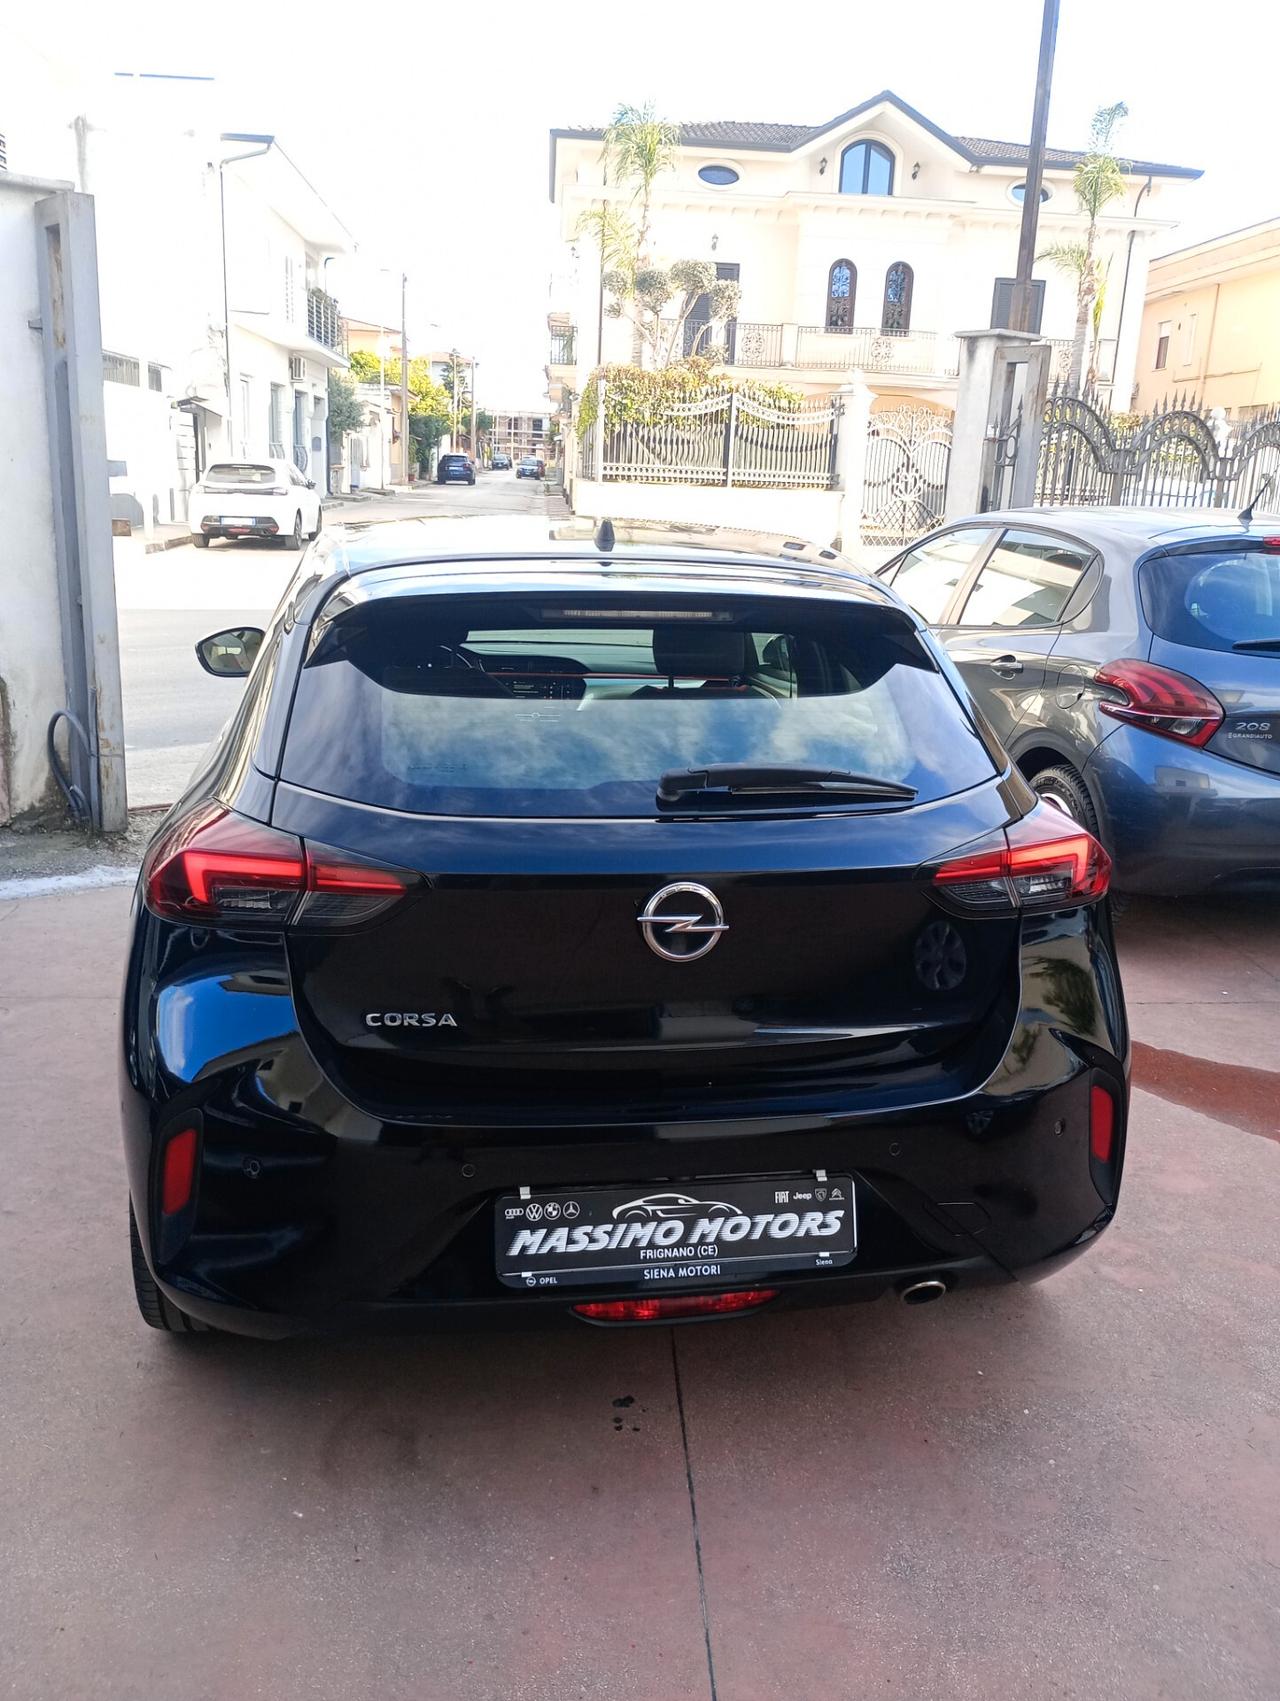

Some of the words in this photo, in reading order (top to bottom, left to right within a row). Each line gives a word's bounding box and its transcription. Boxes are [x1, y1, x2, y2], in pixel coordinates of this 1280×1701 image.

[1235, 722, 1270, 731] 208
[365, 1012, 458, 1027] CORSA
[774, 1191, 790, 1204] FIAT
[793, 1191, 812, 1200] Jeep
[505, 1220, 685, 1257] MASSIMO
[686, 1210, 845, 1244] MOTORS
[640, 1246, 695, 1260] FRIGNANO
[697, 1244, 718, 1258] (CE)
[643, 1267, 676, 1280] SIENA
[678, 1264, 721, 1277] MOTORI
[539, 1276, 558, 1285] OPEL
